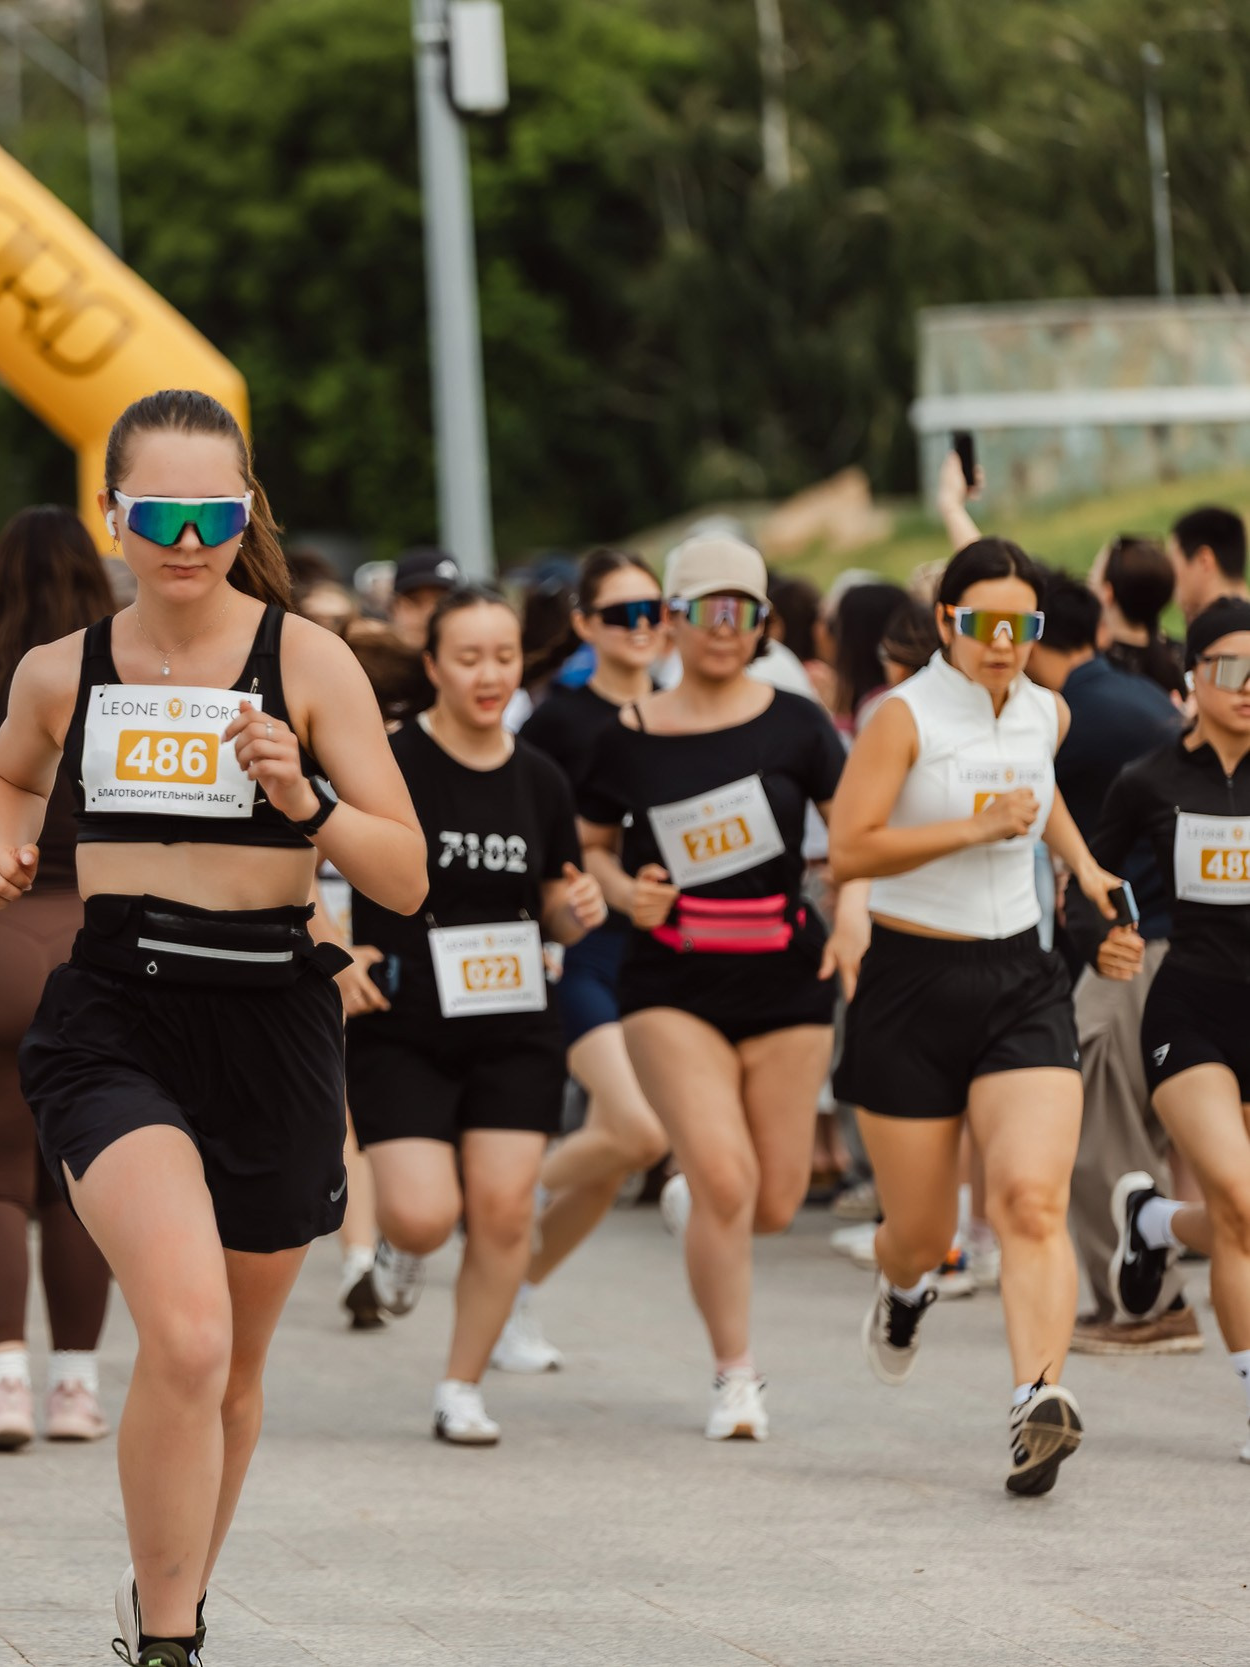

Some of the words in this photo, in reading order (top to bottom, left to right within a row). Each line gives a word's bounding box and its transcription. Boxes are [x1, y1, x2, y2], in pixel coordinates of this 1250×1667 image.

[102, 701, 158, 716] LEONE
[125, 736, 208, 778] 486
[98, 789, 204, 801] БЛАГОТВОРИТЕЛЬНЫЙ
[207, 793, 236, 803] ЗАБЕГ
[438, 830, 528, 874] 7102
